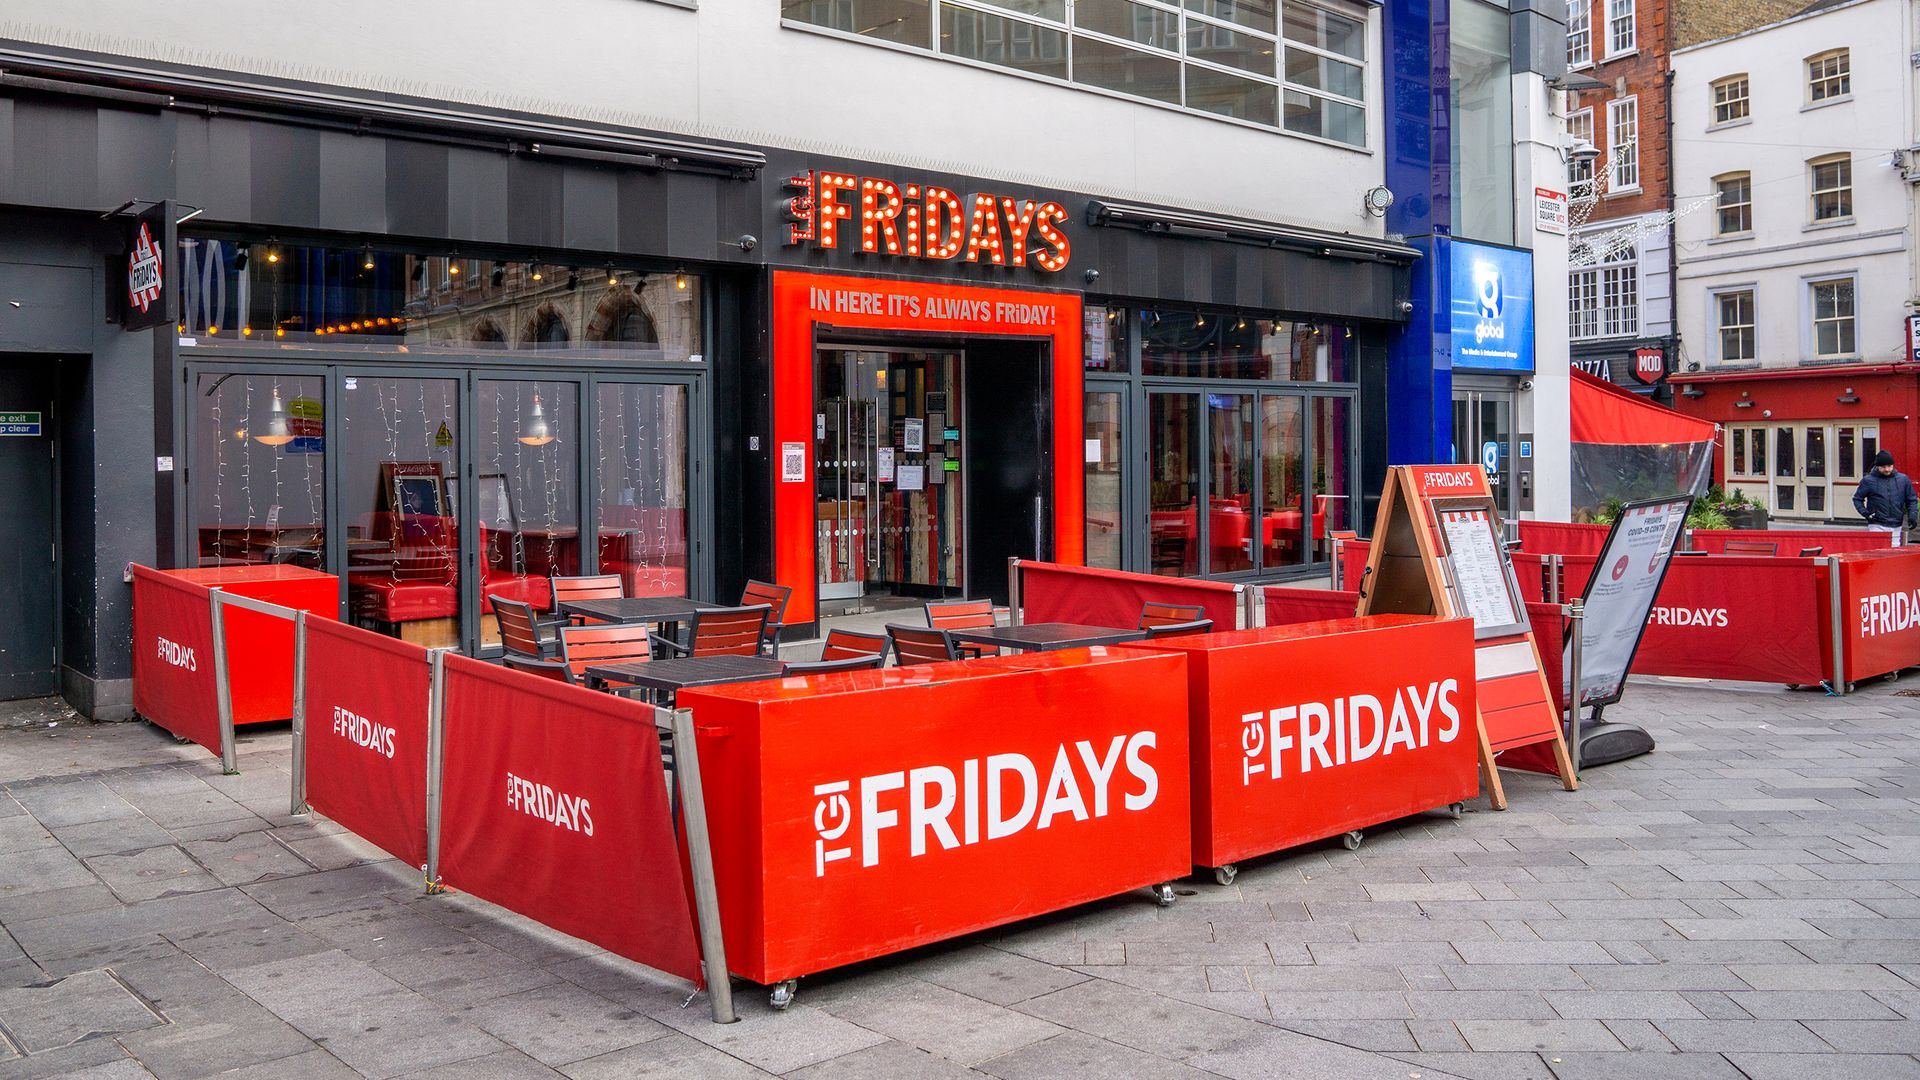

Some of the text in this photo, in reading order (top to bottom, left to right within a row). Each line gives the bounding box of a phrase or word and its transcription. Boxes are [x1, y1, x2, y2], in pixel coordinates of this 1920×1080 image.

[1539, 200, 1560, 212] LEICESTER
[1540, 210, 1565, 224] SQUARE WC2
[835, 291, 883, 315] HERE
[925, 297, 991, 321] ALWAYS
[1475, 319, 1504, 344] global
[1638, 355, 1661, 372] MOD
[8, 414, 26, 422] exit
[1430, 472, 1473, 487] FRIDAYS
[1627, 526, 1649, 537] COVID-19
[1644, 516, 1663, 525] FRIDAYS
[1647, 606, 1729, 627] FRIDAYS
[1860, 597, 1870, 639] TGI
[162, 638, 197, 672] FRIDAYS
[341, 708, 396, 759] FRIDAYS
[1242, 678, 1460, 786] TGI FRIDAYS
[513, 775, 594, 837] FRIDAYS
[814, 730, 1159, 877] TGI FRIDAYS
